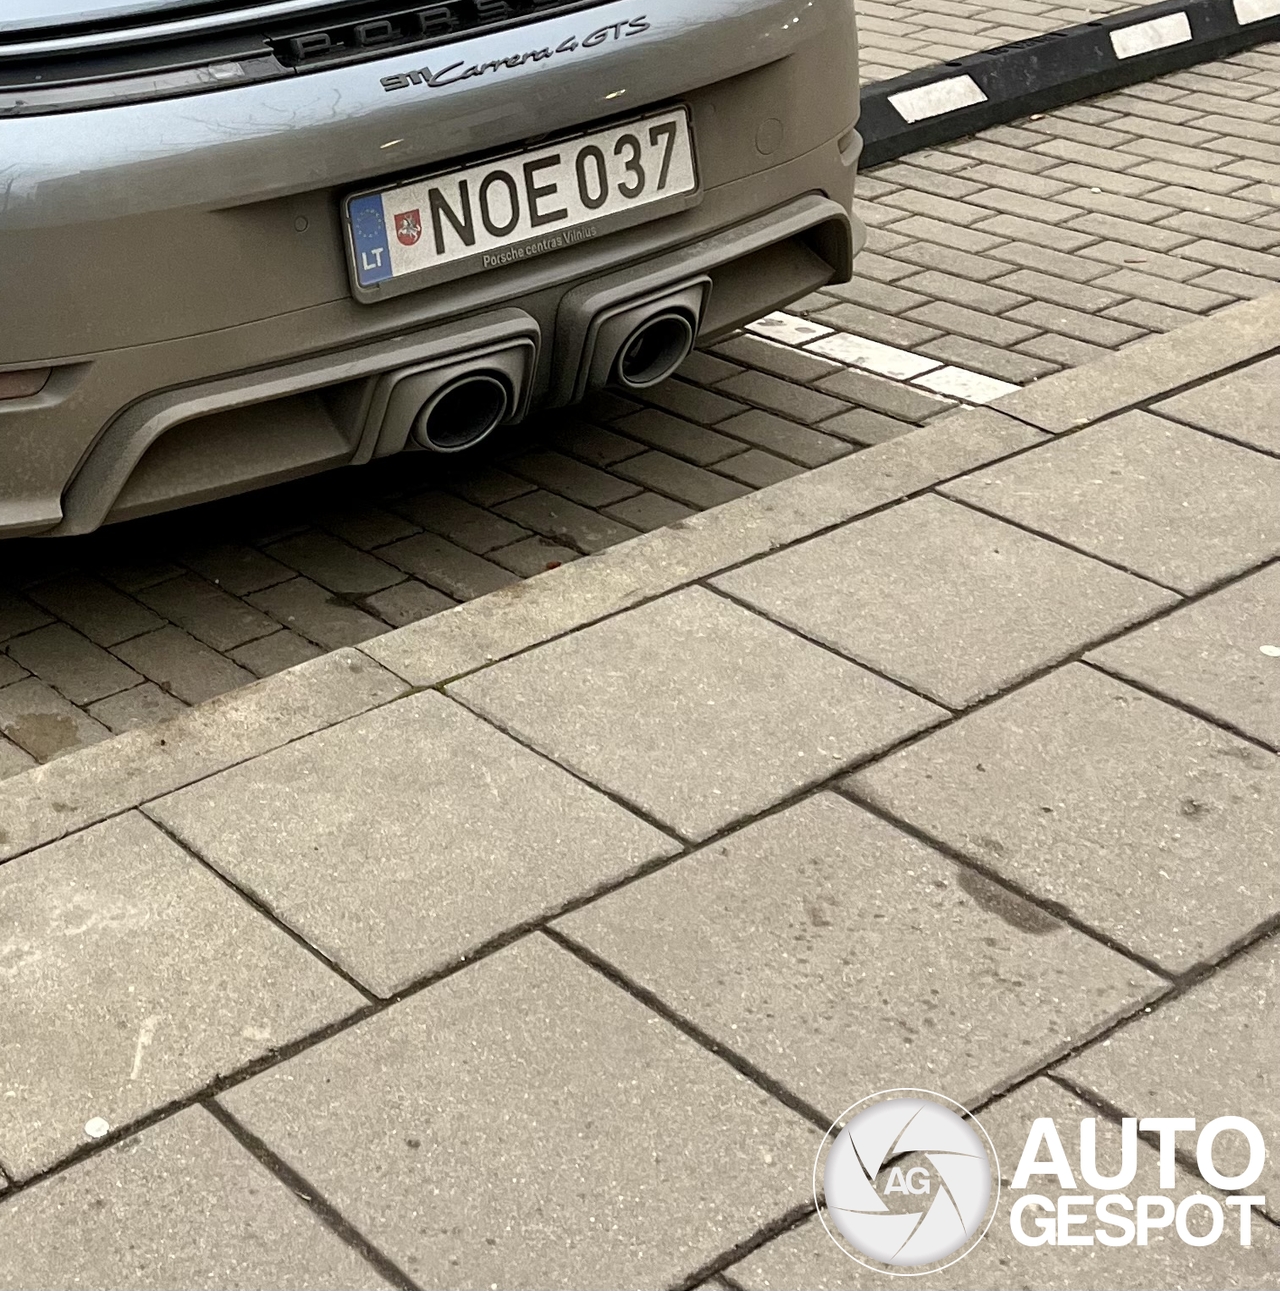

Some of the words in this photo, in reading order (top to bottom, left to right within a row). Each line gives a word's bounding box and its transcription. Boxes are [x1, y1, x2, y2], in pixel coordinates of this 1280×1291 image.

[380, 66, 434, 92] 911
[427, 47, 554, 87] Carrera
[581, 15, 651, 48] GTS
[361, 247, 384, 271] LT
[483, 247, 524, 268] Porsche
[525, 236, 563, 255] centras
[562, 226, 597, 244] Vilnius
